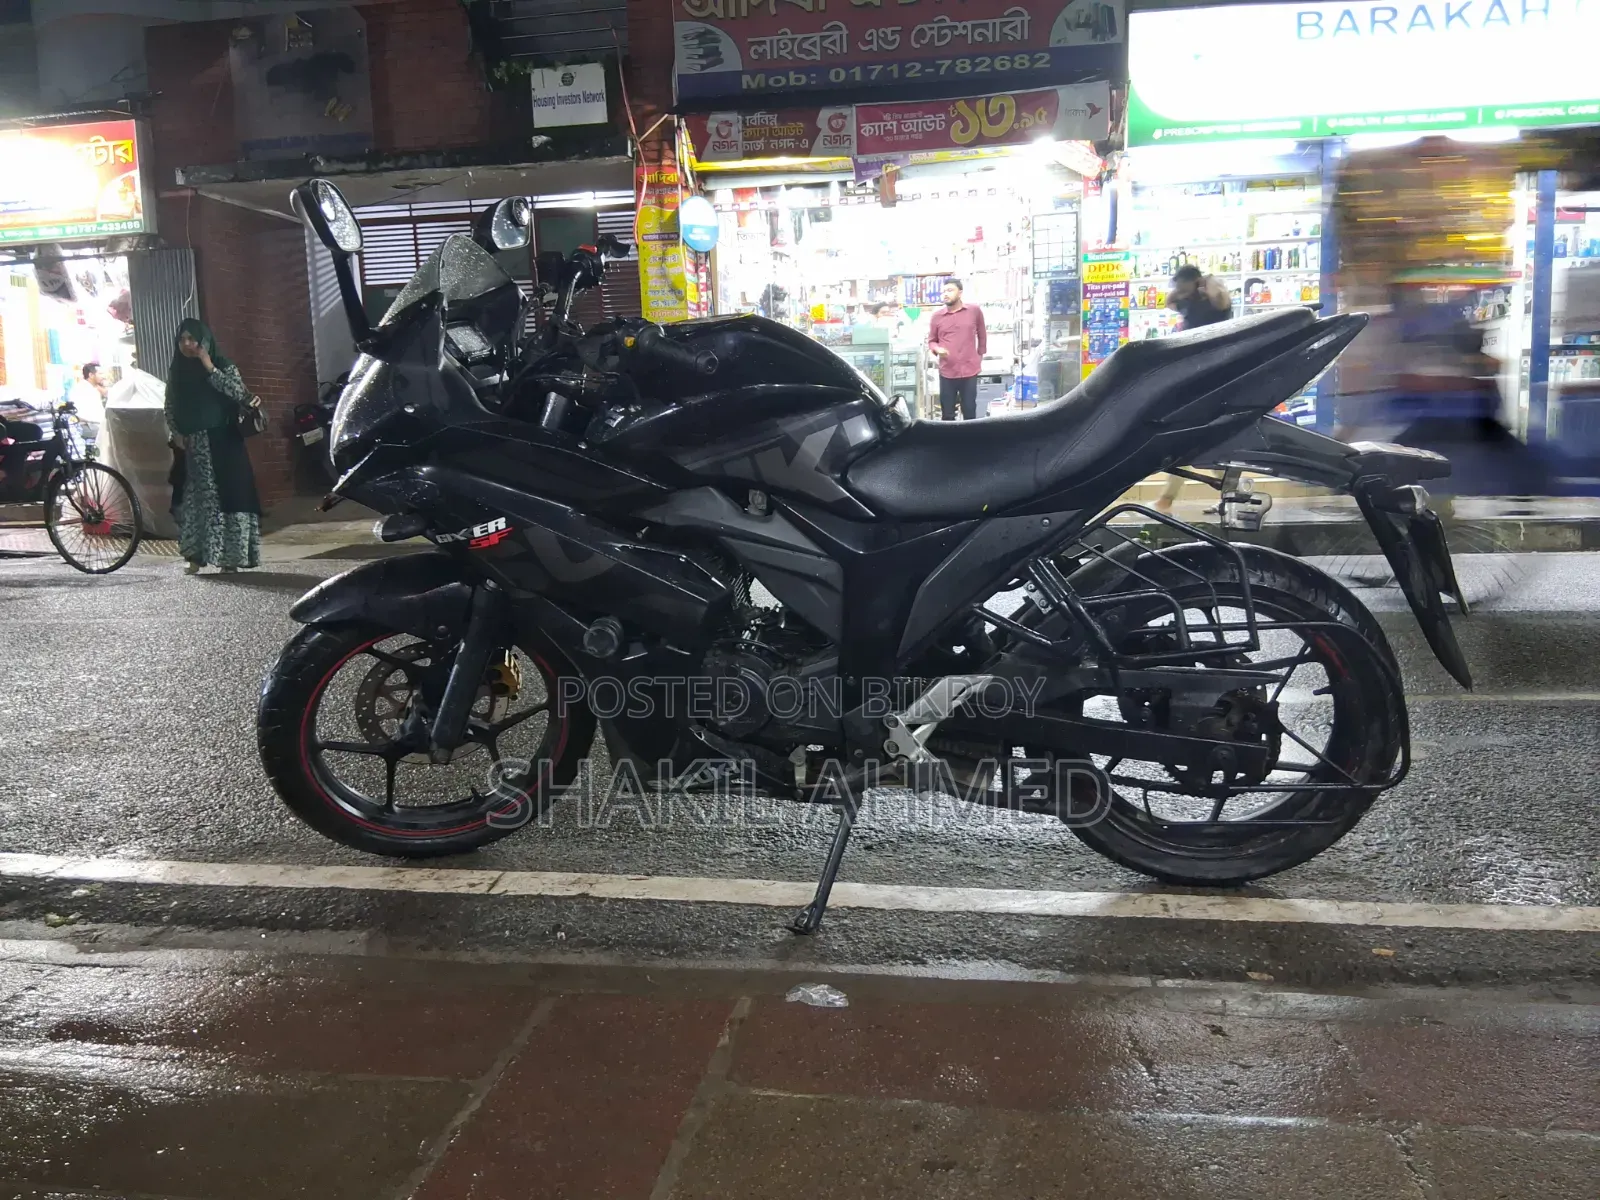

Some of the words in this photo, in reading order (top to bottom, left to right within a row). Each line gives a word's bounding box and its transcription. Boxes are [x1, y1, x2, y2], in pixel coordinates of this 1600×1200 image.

[1296, 0, 1551, 40] BARAKAH
[748, 21, 849, 61] লাইব্রেরী
[858, 26, 903, 51] এন্ড
[911, 7, 1031, 49] স্টেশনারী
[742, 71, 816, 89] Mob:
[828, 53, 1051, 83] 01712-782682
[533, 94, 555, 109] Housing
[556, 91, 582, 106] Investors
[582, 89, 605, 104] Network
[860, 121, 898, 137] ক্যাশ
[900, 113, 946, 133] আউট
[712, 140, 738, 151] নগদ
[822, 134, 852, 147] নগদ
[1101, 282, 1126, 291] pre-paid
